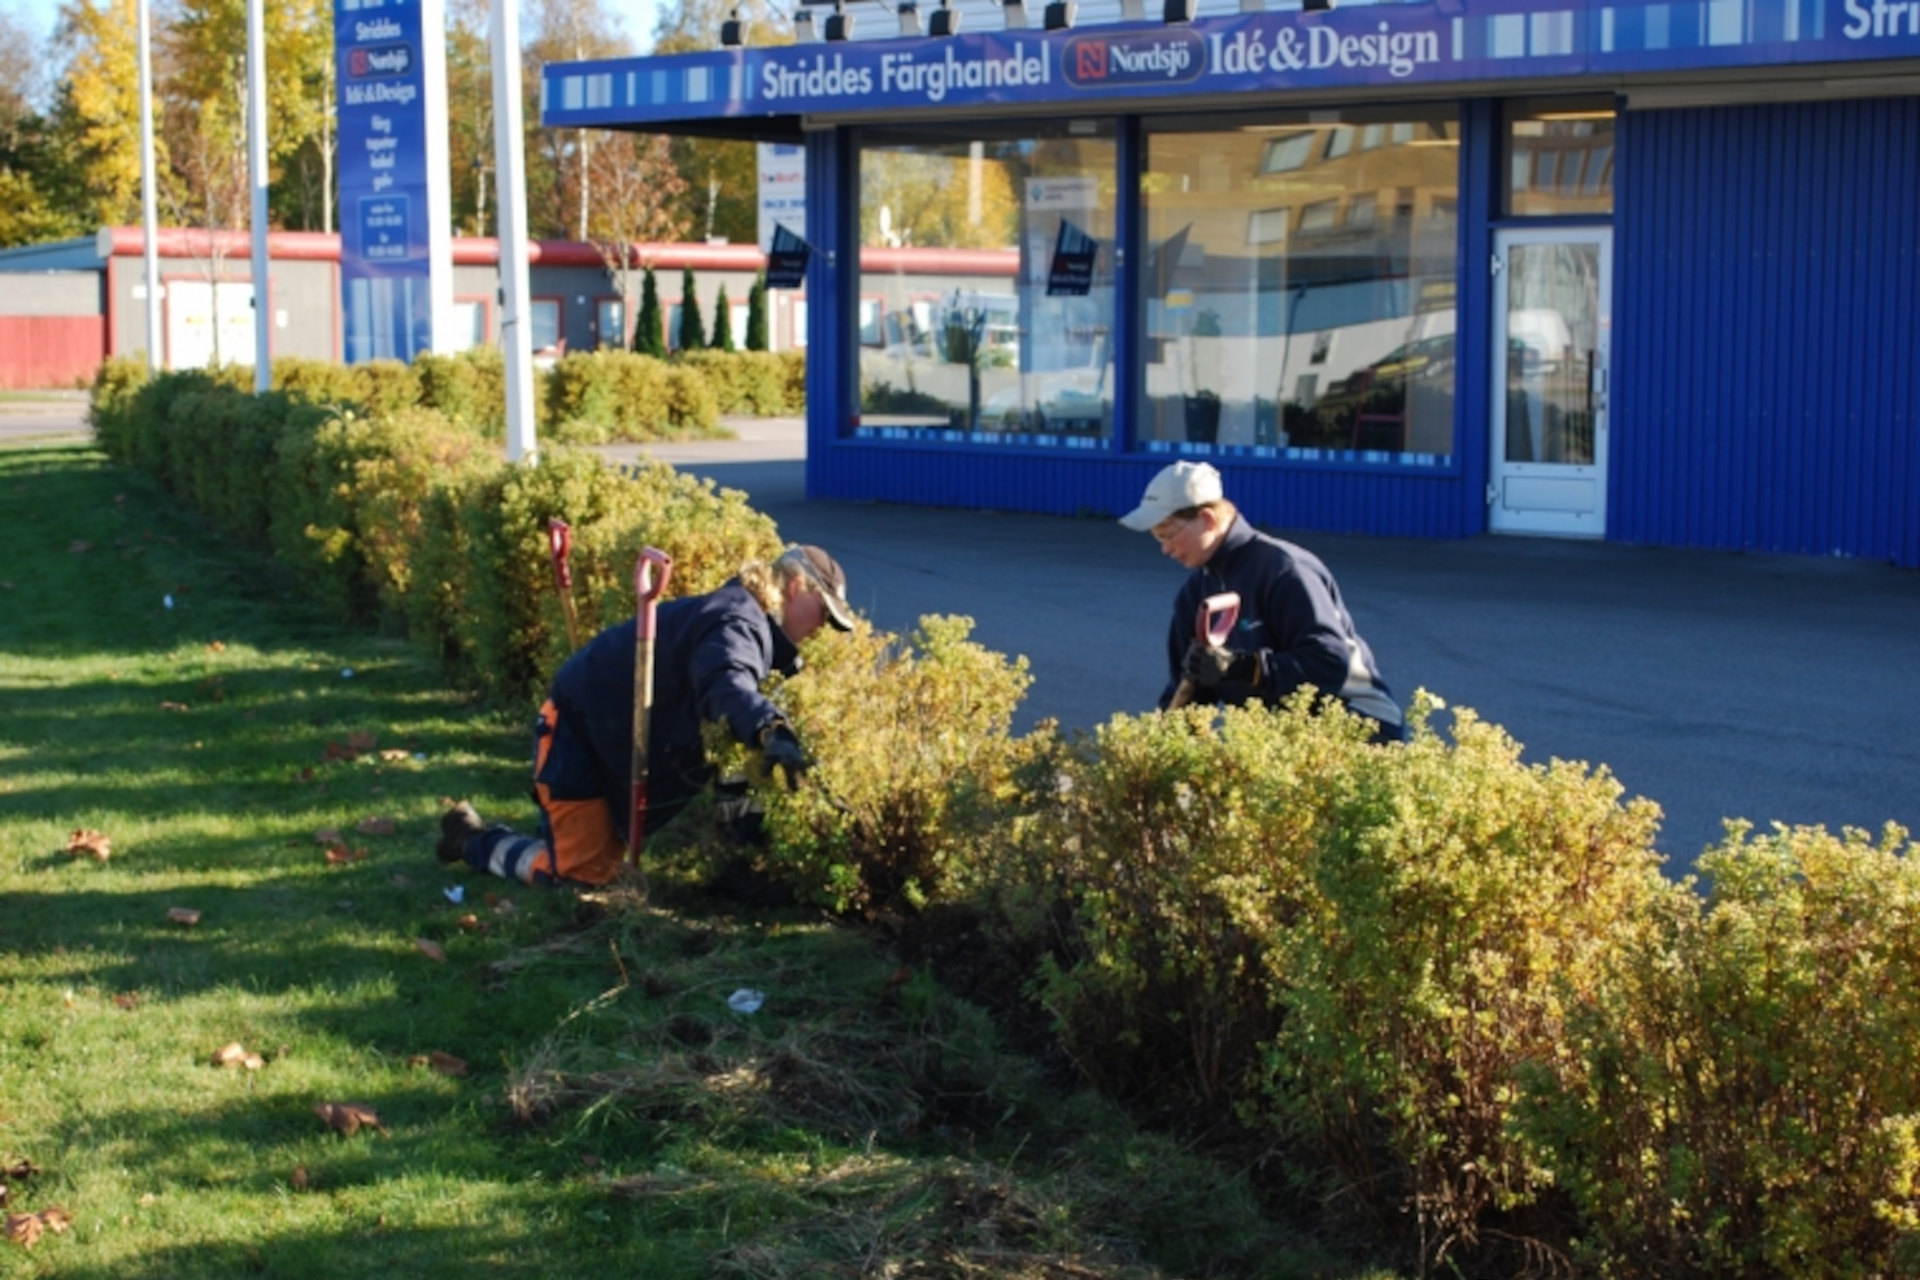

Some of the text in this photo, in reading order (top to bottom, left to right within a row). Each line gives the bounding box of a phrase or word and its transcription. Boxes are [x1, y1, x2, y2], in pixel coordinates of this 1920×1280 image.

[356, 17, 402, 41] Striddes
[762, 39, 1049, 101] Striddes Färghandel
[1110, 41, 1190, 77] Nordsjö
